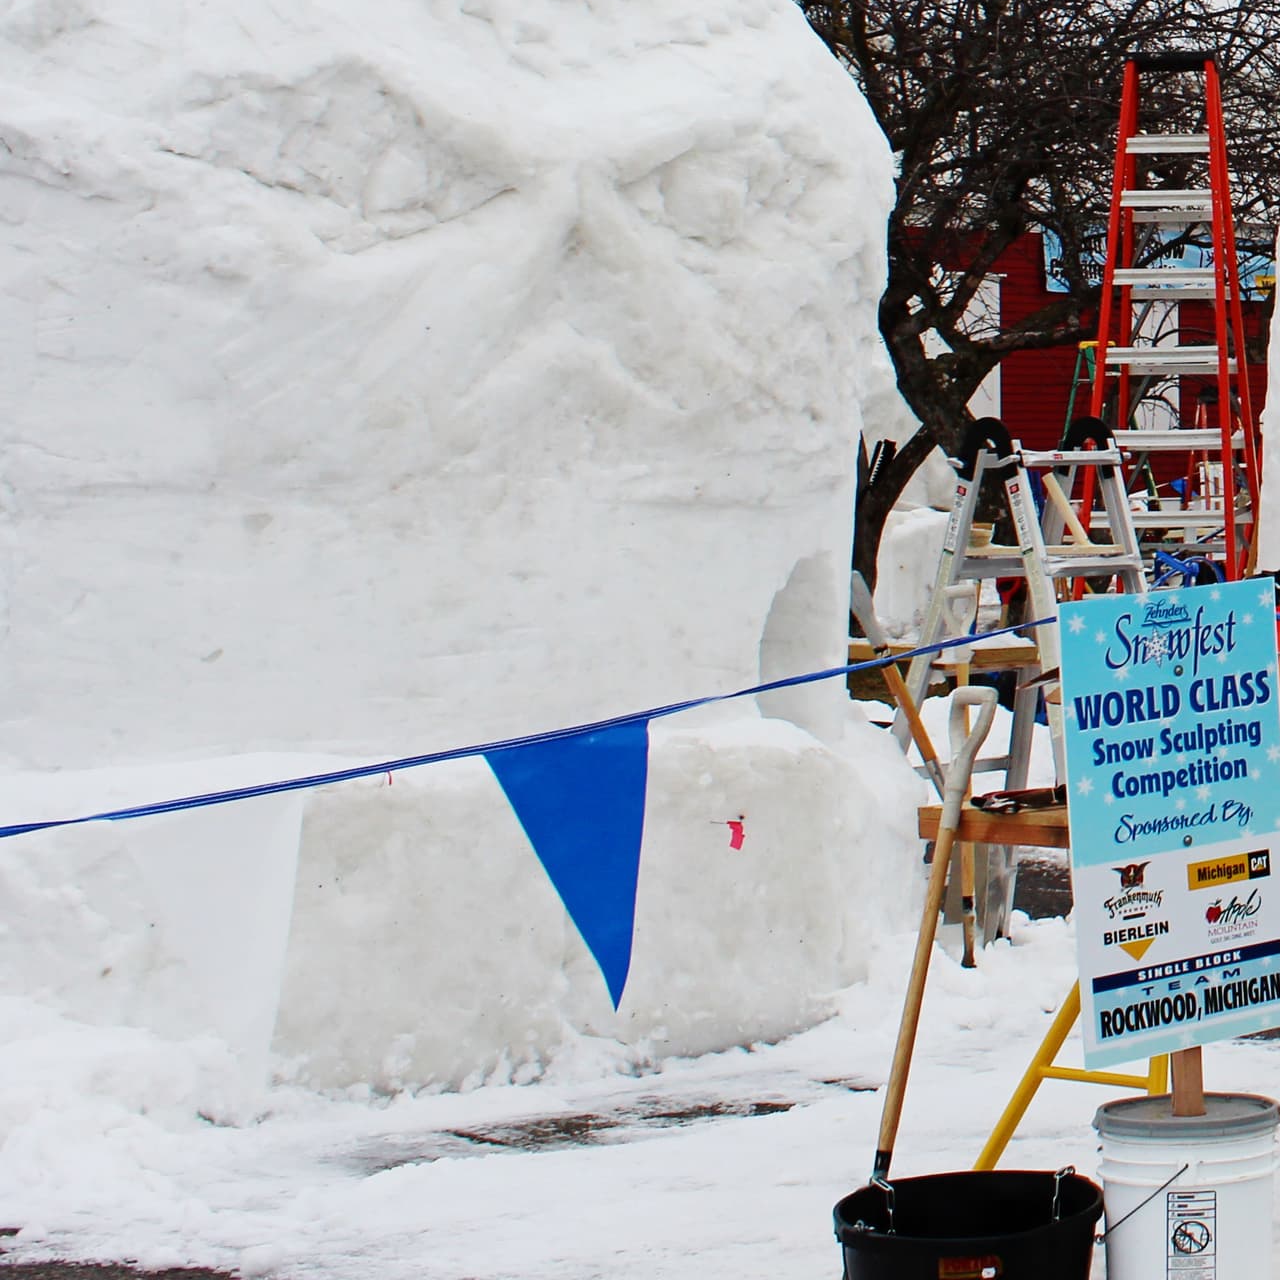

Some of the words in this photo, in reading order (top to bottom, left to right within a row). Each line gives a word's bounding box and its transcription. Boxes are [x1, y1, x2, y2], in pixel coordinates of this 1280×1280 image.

[1074, 683, 1180, 731] WORLD
[1190, 670, 1271, 713] CLASS
[1093, 736, 1154, 766] Snow
[1160, 719, 1261, 756] Sculpting
[1112, 758, 1248, 798] Competition
[1115, 804, 1217, 844] Sponsored
[1197, 863, 1246, 882] Michigan
[1251, 856, 1267, 871] CAT
[1104, 887, 1164, 919] Frankenmuth
[1219, 888, 1262, 924] Apple
[1104, 921, 1169, 946] BIERLEIN
[1208, 919, 1259, 937] MOUNTAIN
[1137, 963, 1189, 981] SINGLE
[1195, 951, 1241, 969] BLOCK
[1142, 967, 1241, 995] TEAM
[1101, 990, 1203, 1039] ROCKWOOD,
